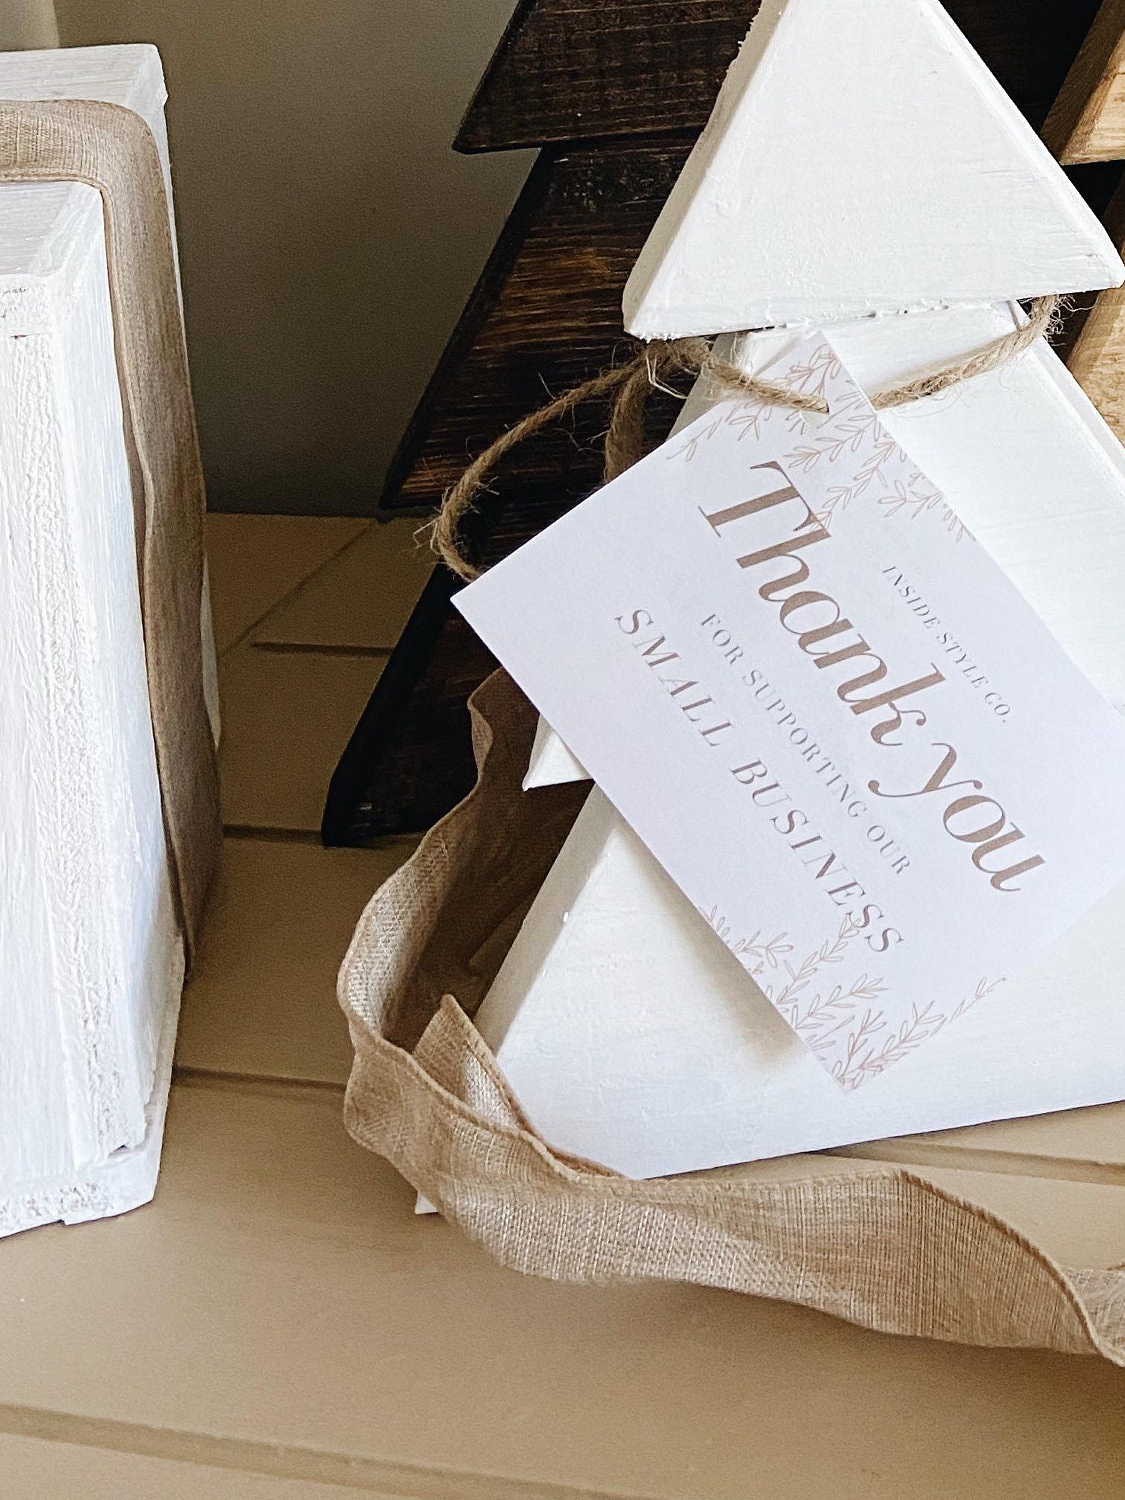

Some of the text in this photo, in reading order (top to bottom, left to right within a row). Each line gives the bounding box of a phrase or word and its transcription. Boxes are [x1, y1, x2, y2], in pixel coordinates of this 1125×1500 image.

[614, 609, 905, 954] SMALL BUSINESS
[697, 460, 1046, 893] Thank you
[701, 613, 911, 875] FOR SUPPORTING OUR
[882, 565, 1011, 723] INSIDE STYLE CO.
